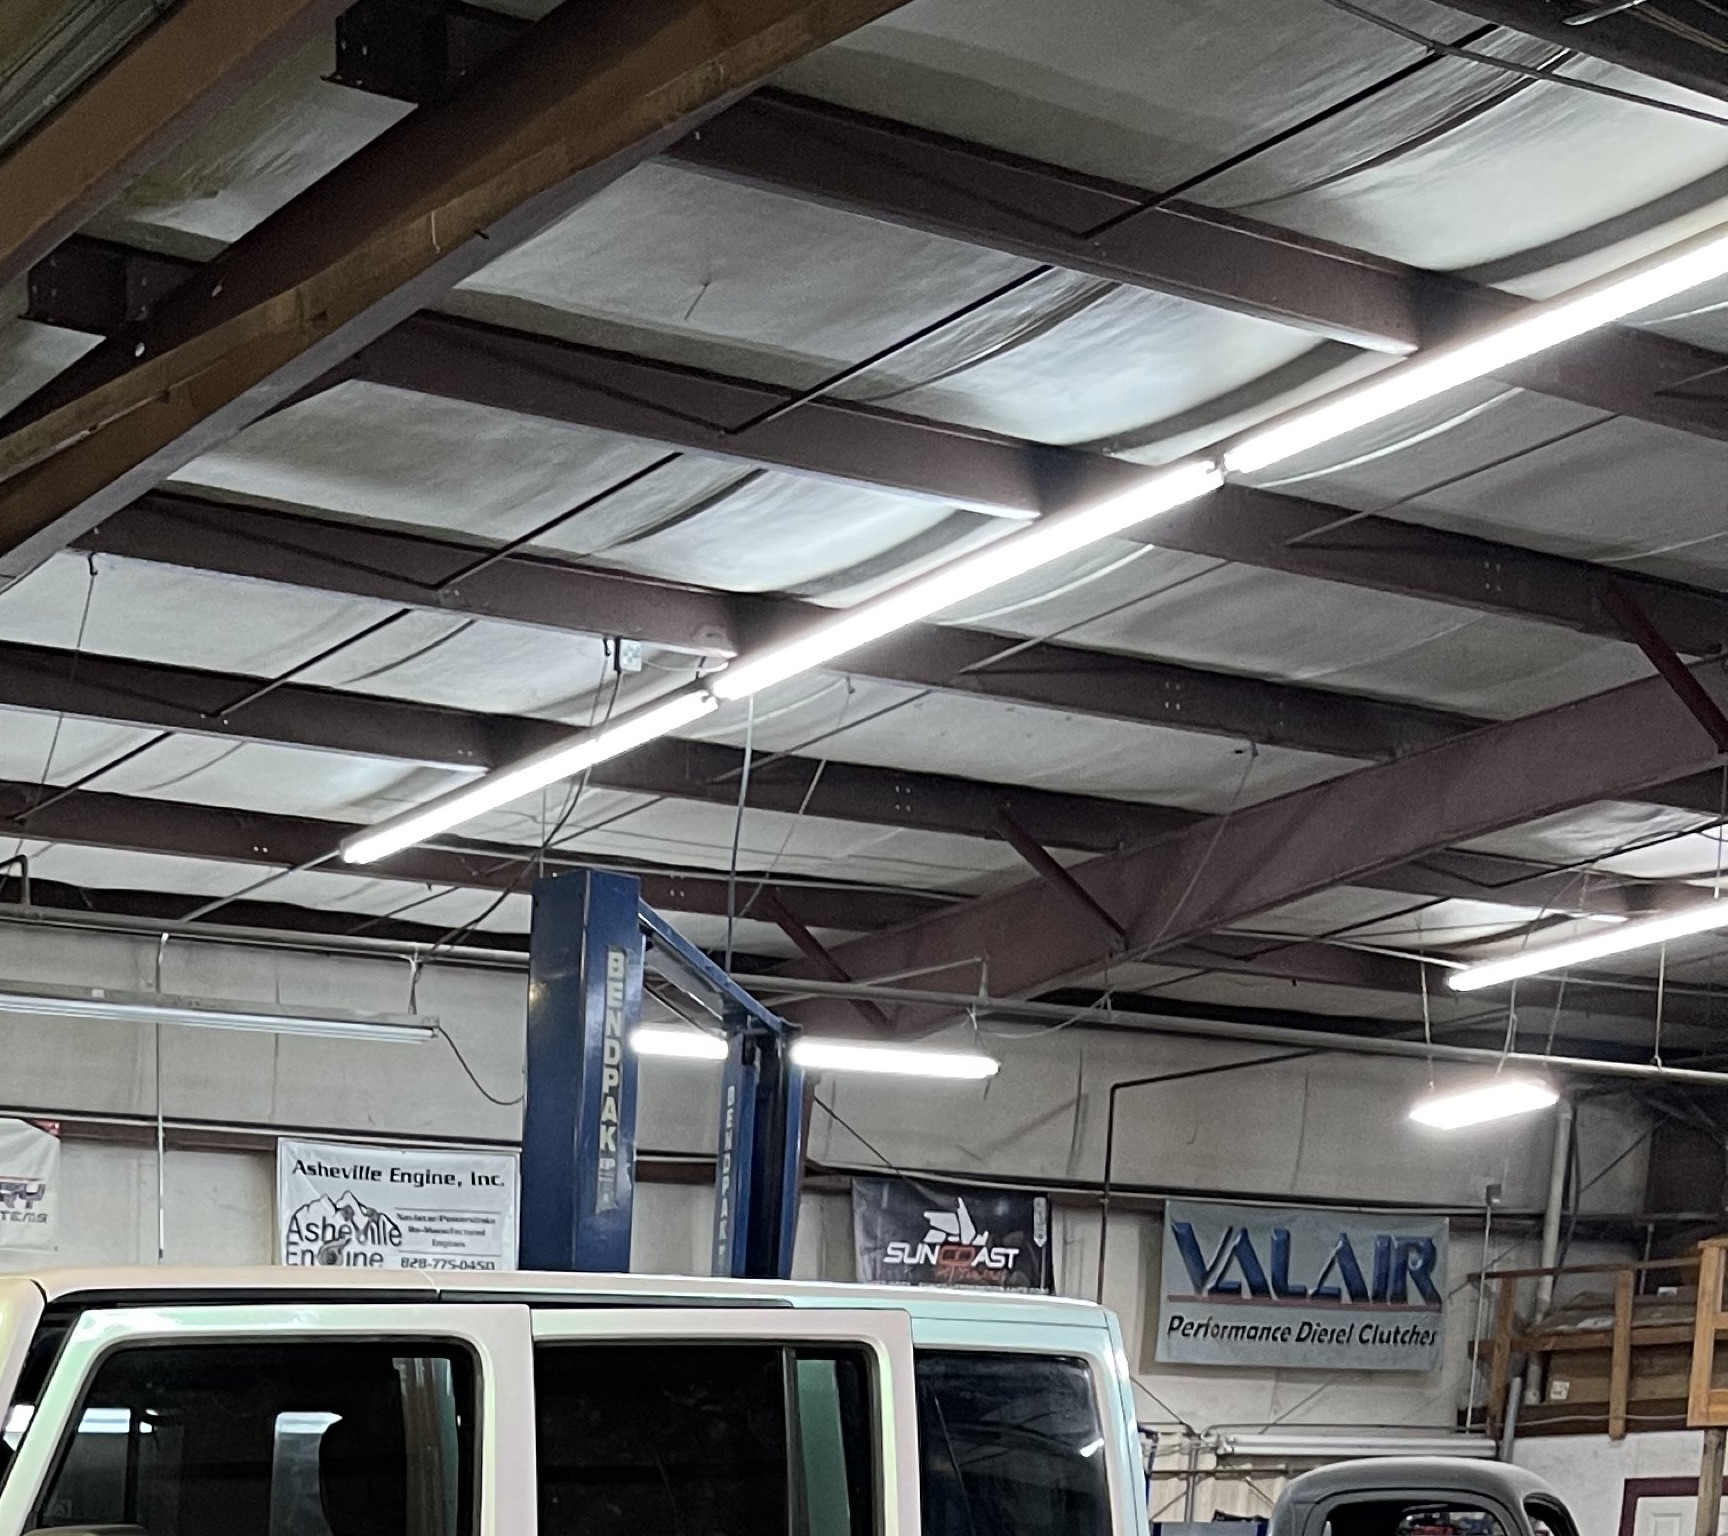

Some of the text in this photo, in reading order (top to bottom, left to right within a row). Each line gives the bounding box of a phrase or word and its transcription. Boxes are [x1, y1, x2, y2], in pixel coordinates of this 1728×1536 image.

[599, 951, 625, 1152] BENDPAK
[292, 1159, 505, 1188] Asheville Engine, Inc.
[883, 1241, 1020, 1269] SUNCOAST
[1171, 1220, 1442, 1305] VALAIR
[1167, 1315, 1436, 1346] Performance Diesel Clutches
